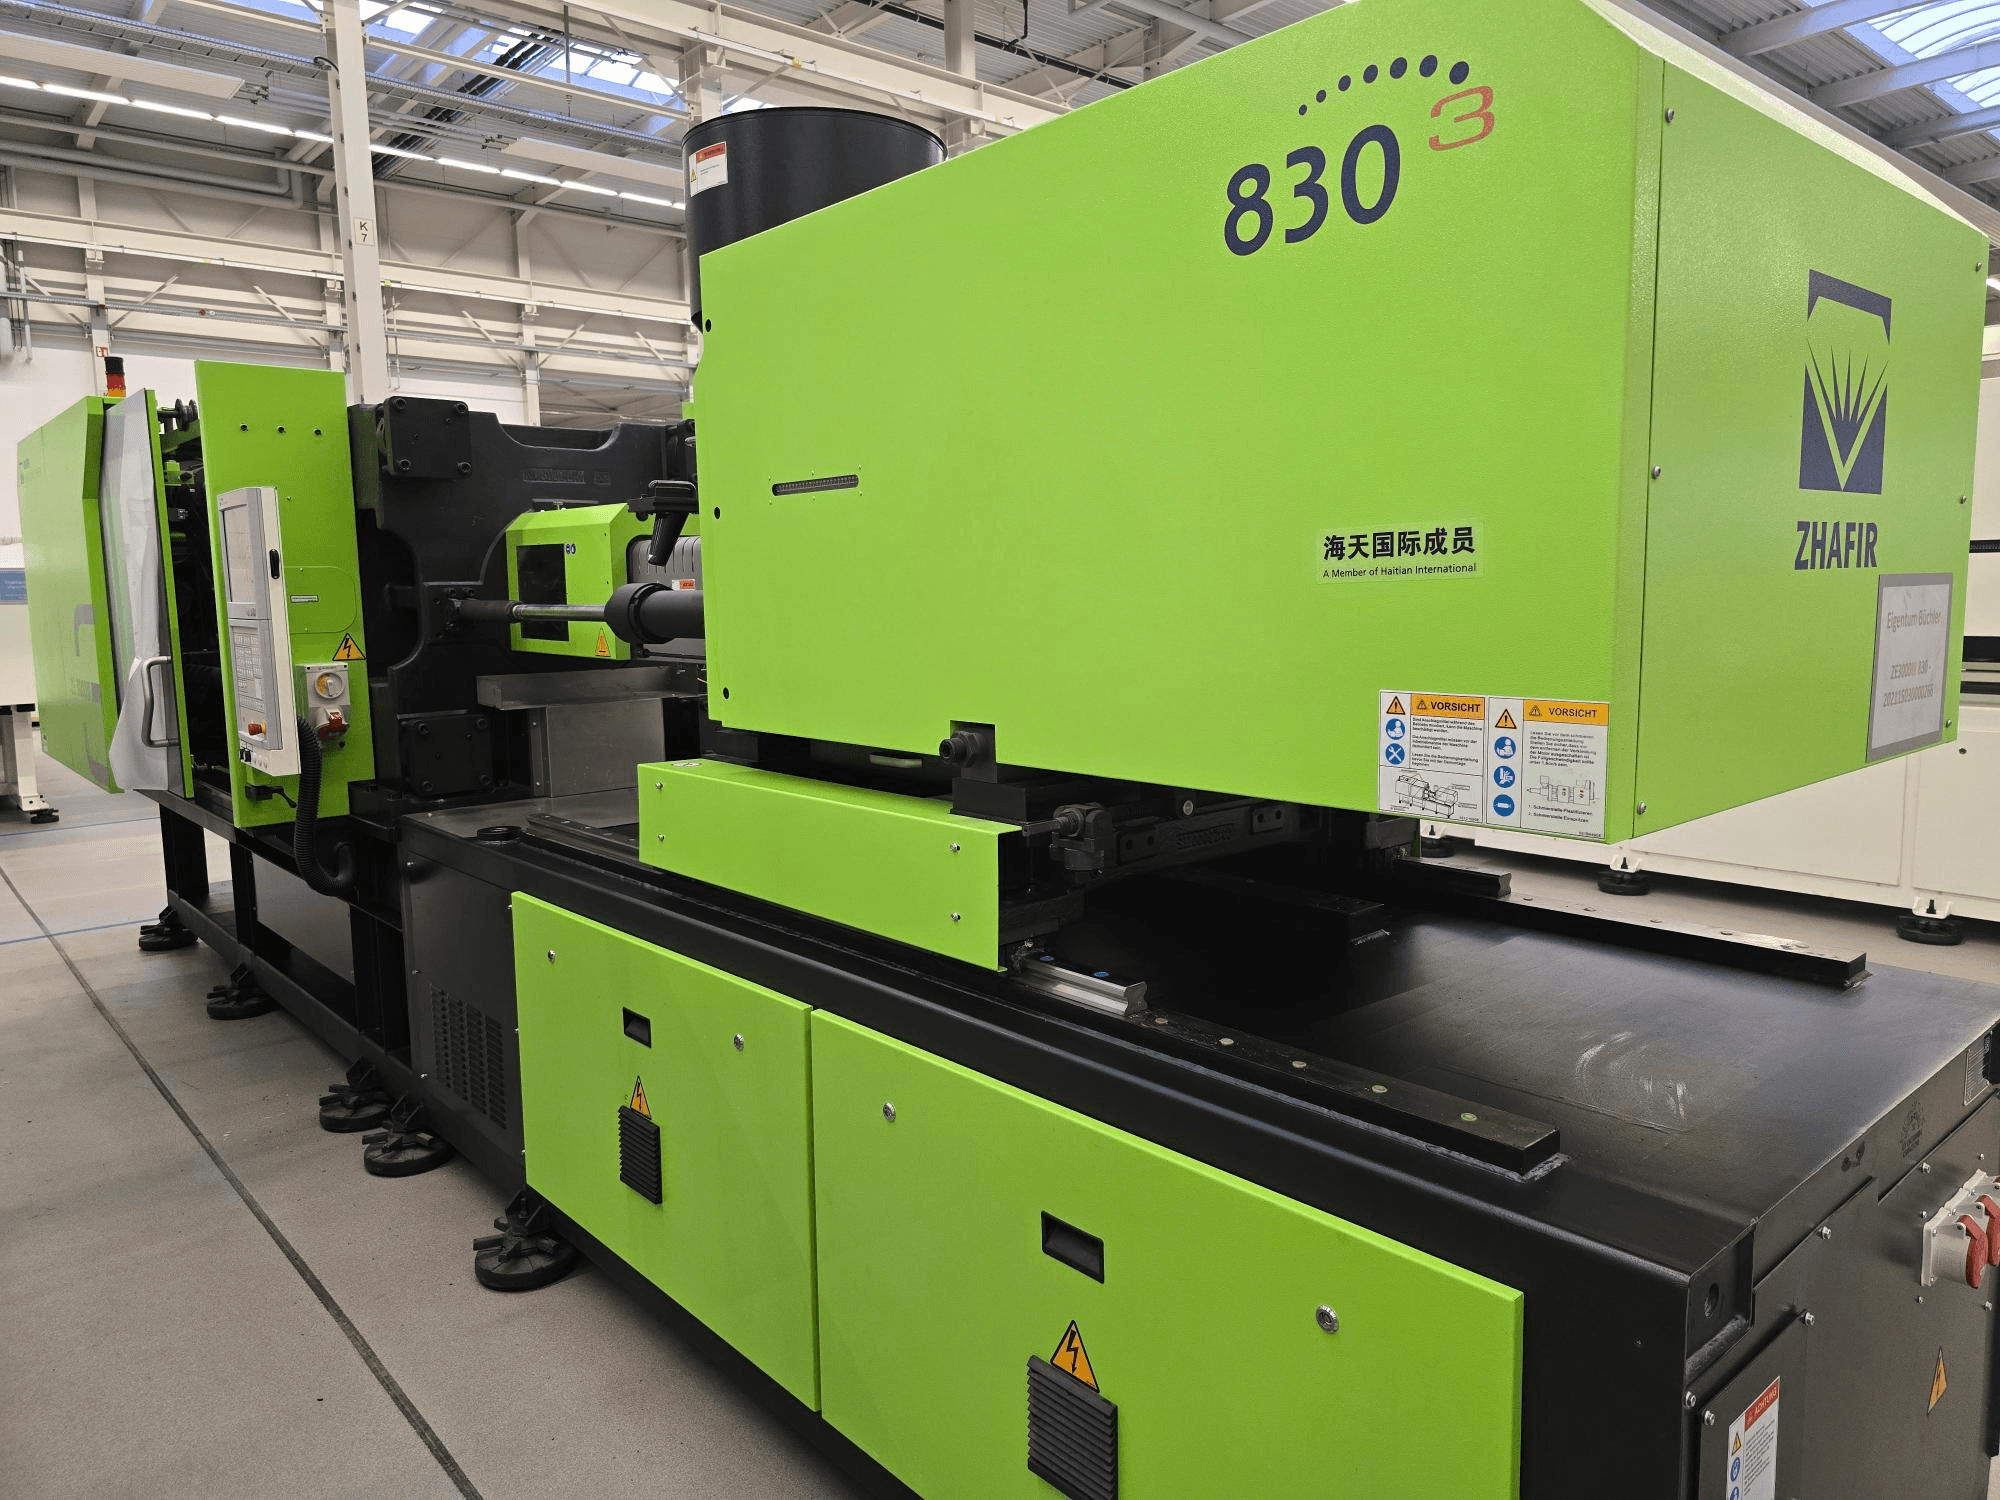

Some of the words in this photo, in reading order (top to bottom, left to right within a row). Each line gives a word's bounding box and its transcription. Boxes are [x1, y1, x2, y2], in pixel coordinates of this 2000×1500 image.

[1224, 124, 1401, 256] 830
[1429, 86, 1495, 151] 3
[360, 221, 368, 231] K
[361, 233, 368, 242] 7
[1323, 527, 1476, 560] 海天国际成员
[1795, 520, 1878, 570] ZHAFIR
[1323, 570, 1330, 578] A
[1331, 568, 1366, 578] Member
[1369, 567, 1379, 576] of
[1380, 566, 1413, 576] Haitian
[1415, 563, 1476, 574] International
[1887, 611, 1918, 632] Eigentum
[1918, 608, 1942, 626] Büchler
[1430, 701, 1481, 713] VORSICHT
[1548, 707, 1597, 718] VORSICHT
